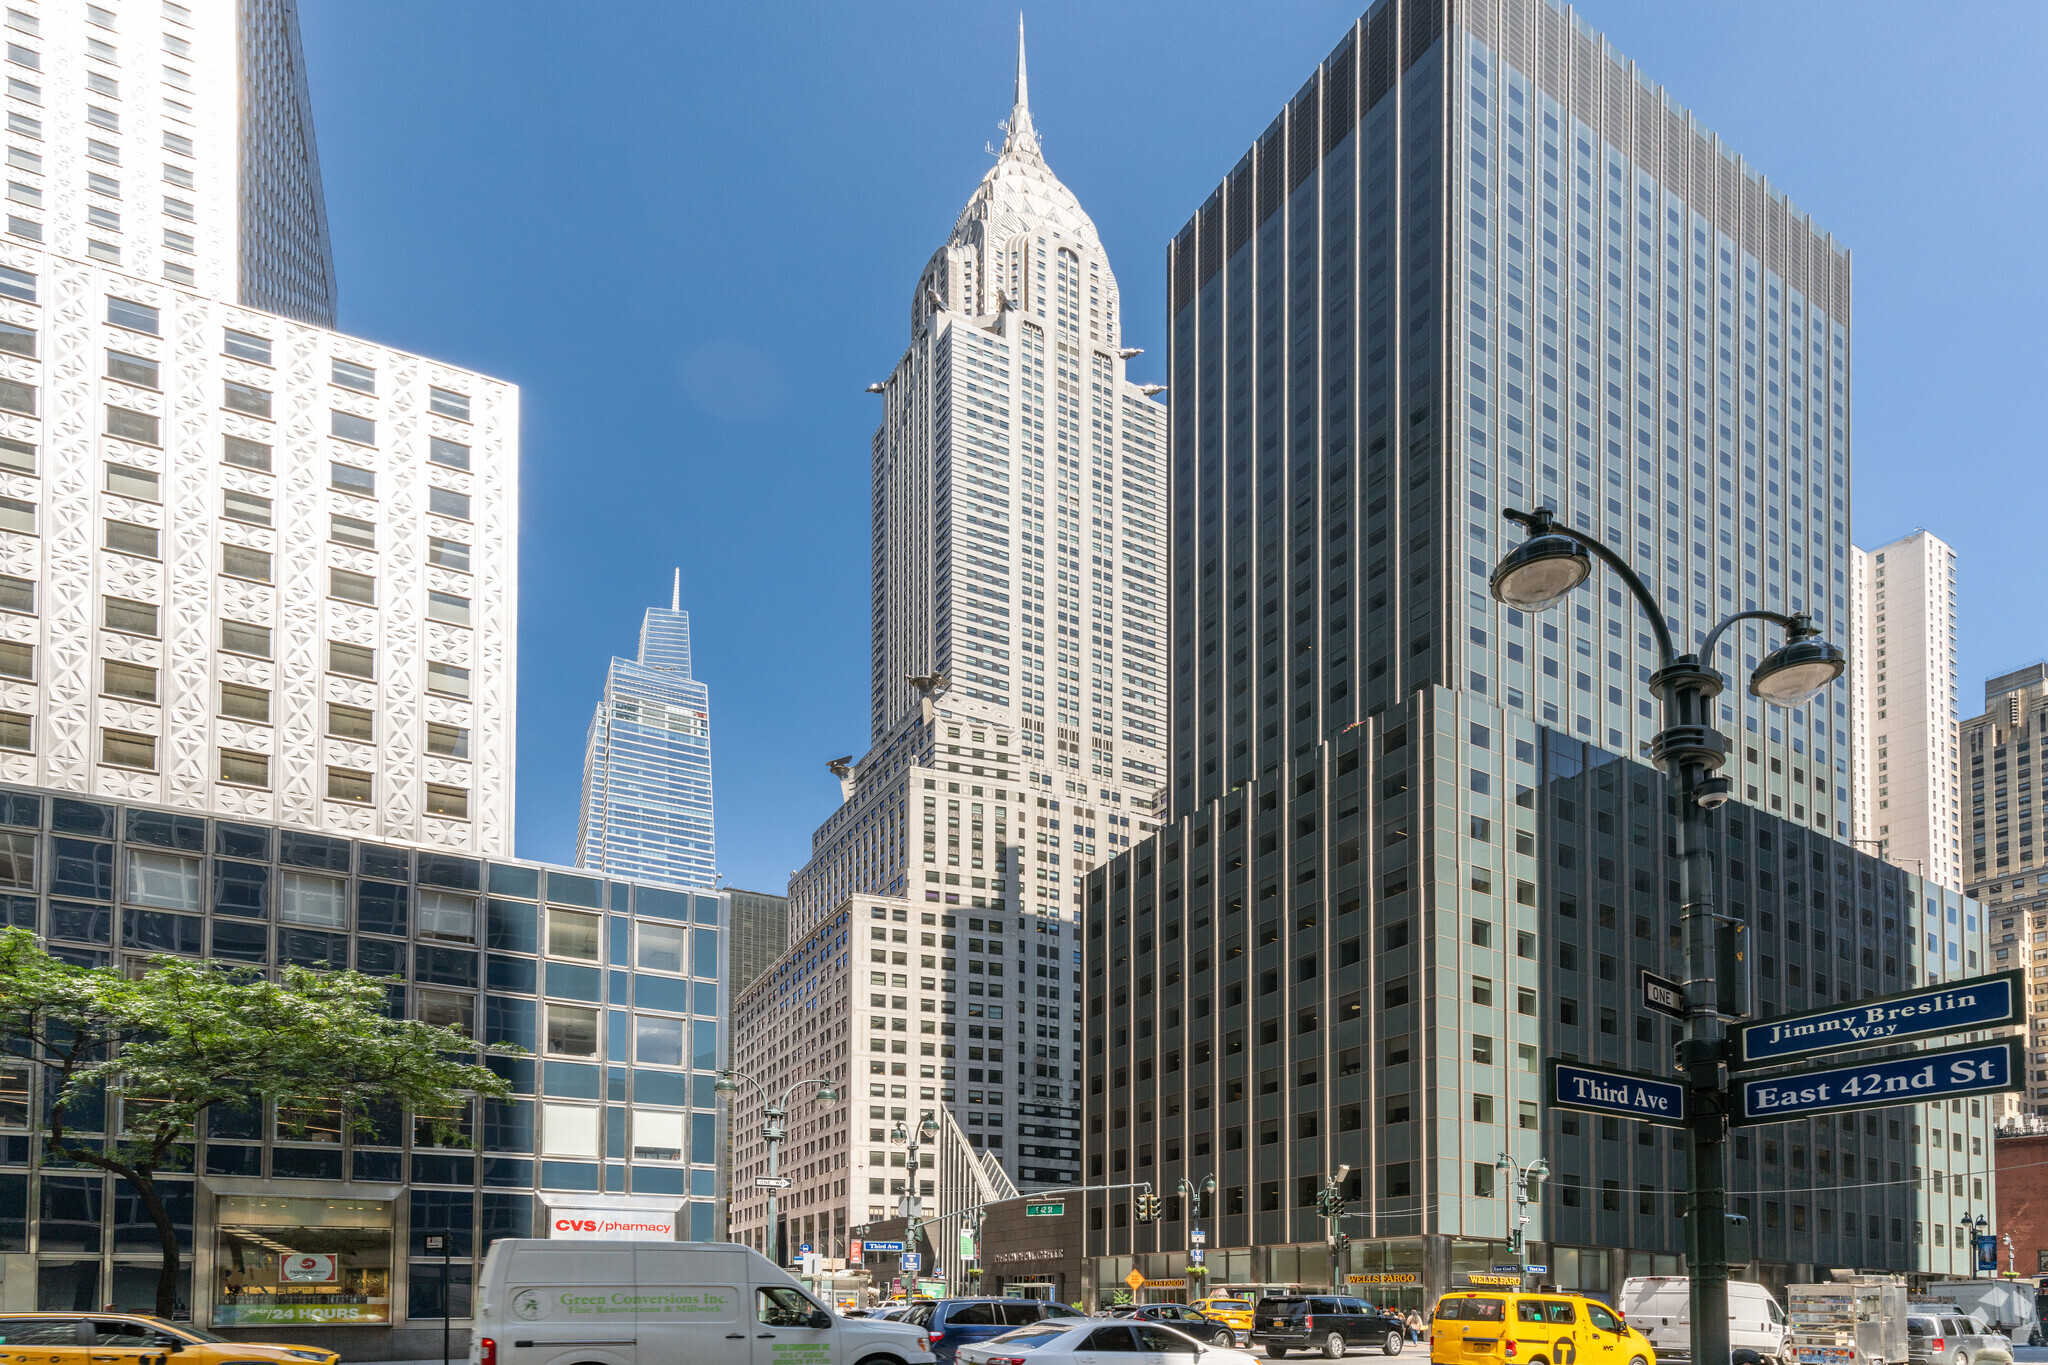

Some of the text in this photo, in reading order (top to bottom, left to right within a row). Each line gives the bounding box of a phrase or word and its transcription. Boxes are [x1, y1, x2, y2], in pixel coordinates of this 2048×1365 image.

[1653, 987, 1671, 1005] ONE
[1769, 994, 1976, 1044] Jimmy Breslin
[1850, 1024, 1897, 1039] Way
[1755, 1060, 1995, 1109] East 42nd St
[1572, 1076, 1668, 1110] Third Ave
[1347, 1274, 1416, 1284] WELLS FARGO
[1468, 1274, 1521, 1286] WELLS FARG
[560, 1293, 729, 1305] Green Conversions Inc.
[300, 1308, 360, 1319] HOURS
[568, 1305, 722, 1314] Fine Renovations & Millwork
